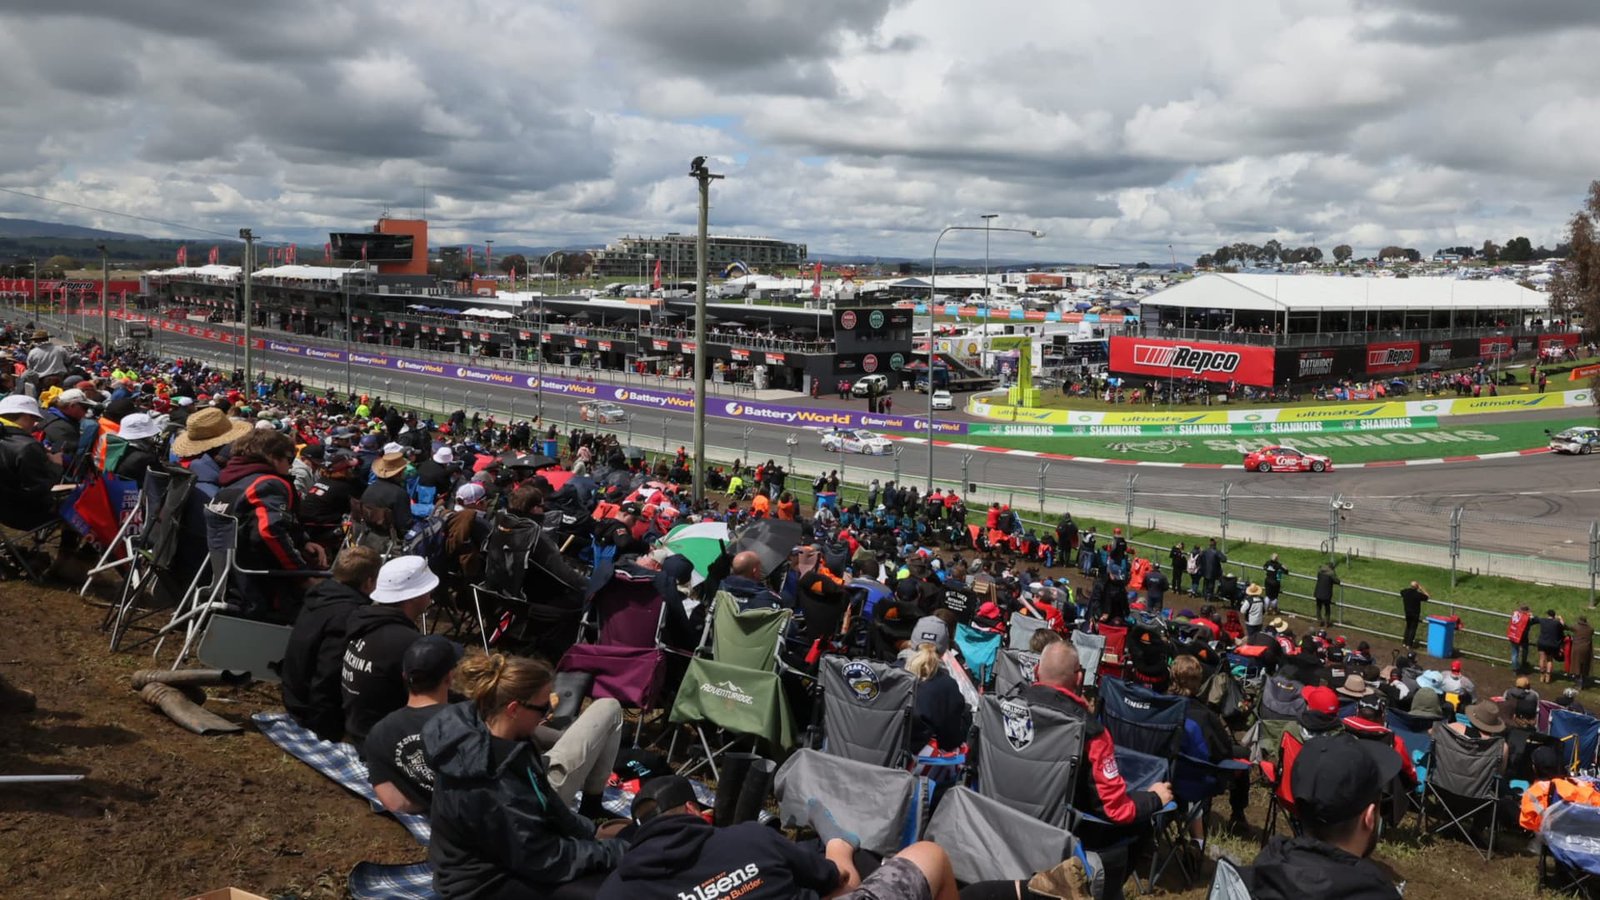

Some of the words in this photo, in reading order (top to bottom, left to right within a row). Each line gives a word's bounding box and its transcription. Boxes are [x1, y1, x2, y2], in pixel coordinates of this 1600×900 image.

[354, 355, 387, 365] BatteryWorld
[1172, 345, 1240, 374] Repco
[1387, 348, 1414, 366] Repco
[404, 361, 443, 373] BatteryWorld
[466, 370, 513, 383] BatteryWorld
[1470, 399, 1526, 409] ultimate
[744, 406, 850, 425] BatteryWorld
[1296, 408, 1360, 418] ultimate
[868, 418, 903, 428] BatteryWorld
[1121, 415, 1183, 423] ultimate
[1360, 417, 1412, 430] SHANNONS
[1004, 425, 1054, 435] SHANNONS
[1090, 425, 1142, 435] SHANNONS
[1179, 424, 1232, 435] SHANNONS
[1270, 421, 1323, 434] SHANNONS
[729, 877, 764, 898] Builder.
